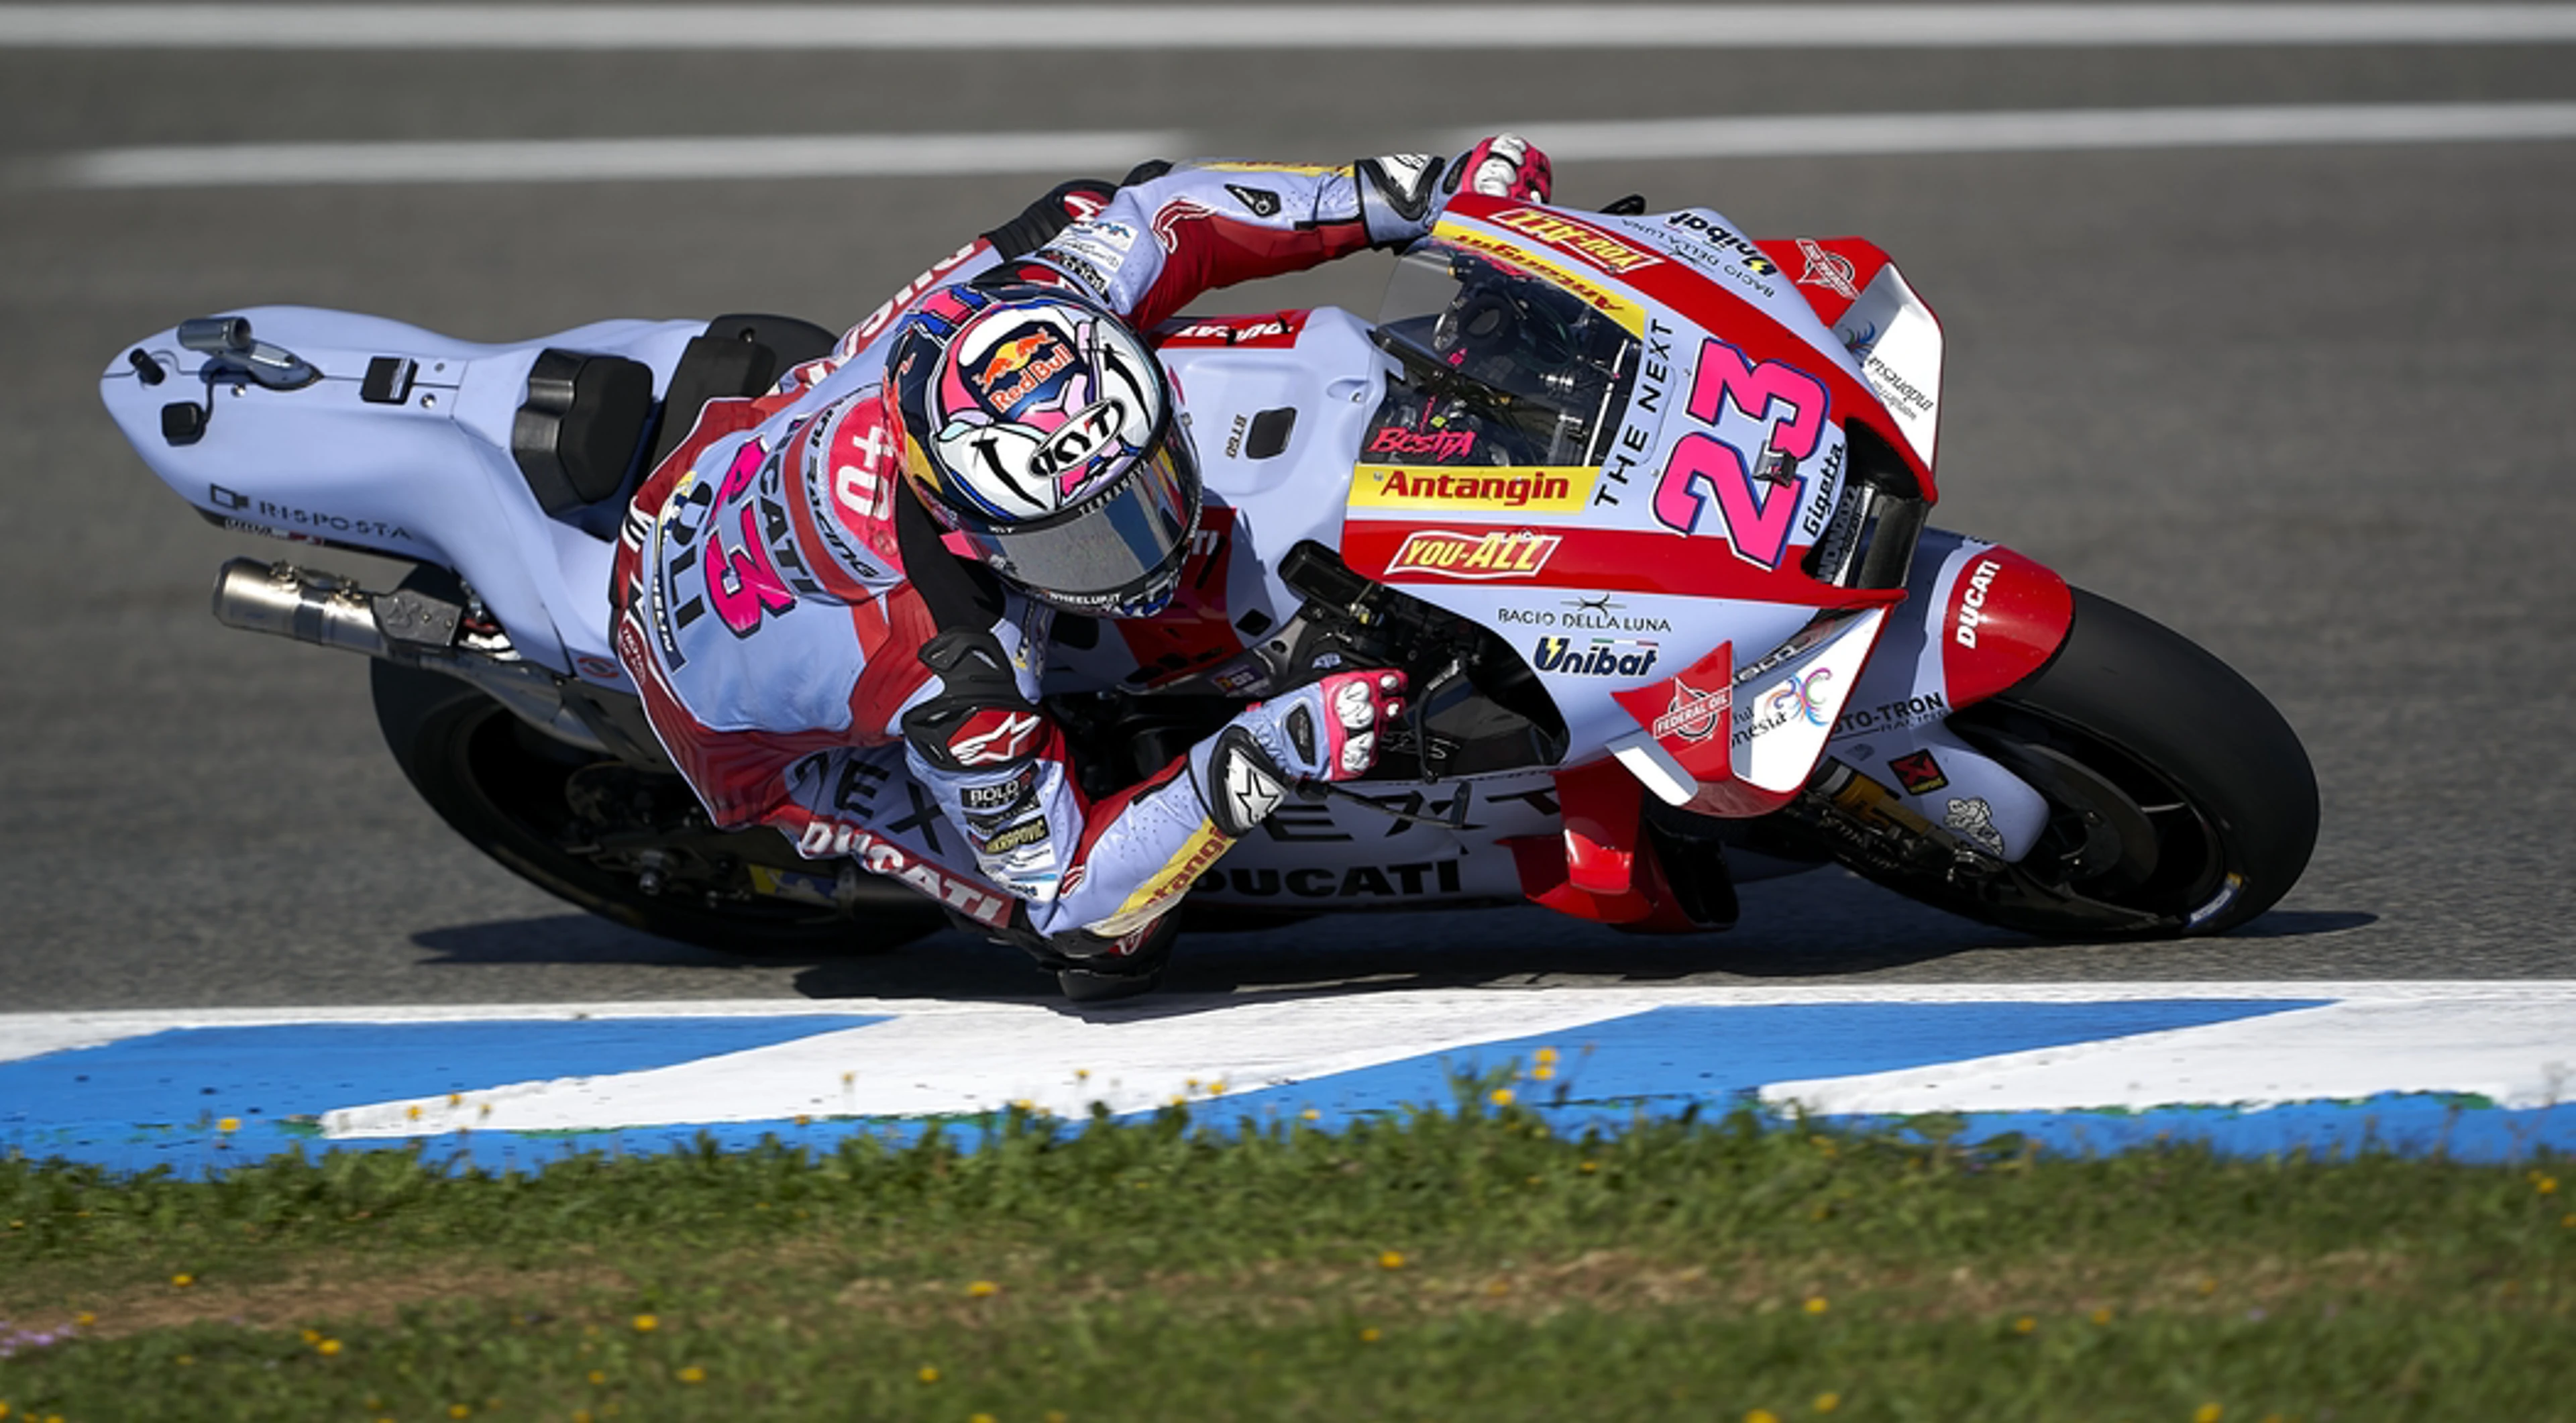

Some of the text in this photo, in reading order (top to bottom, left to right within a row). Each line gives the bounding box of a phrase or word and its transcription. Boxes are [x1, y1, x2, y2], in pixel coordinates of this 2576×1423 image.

[1668, 212, 1779, 277] Unibat
[1723, 264, 1775, 299] BACIO
[989, 342, 1076, 413] Red Bull
[1032, 407, 1111, 475] KYT
[1594, 318, 1674, 509] THE NEXT
[1650, 335, 1831, 572] 23
[1381, 471, 1569, 506] Antangin
[1803, 442, 1845, 537] Gigetta
[1403, 534, 1542, 571] YOU-ALL
[1499, 608, 1672, 632] BACIO DELLA LUNA
[1955, 560, 2002, 648] DUCATI
[1534, 637, 1657, 677] Unibat
[1656, 686, 1732, 736] FEDERAL OIL
[1834, 692, 1944, 733] TO-TRON
[794, 749, 947, 857] NEX
[804, 821, 1005, 923] DUCATI
